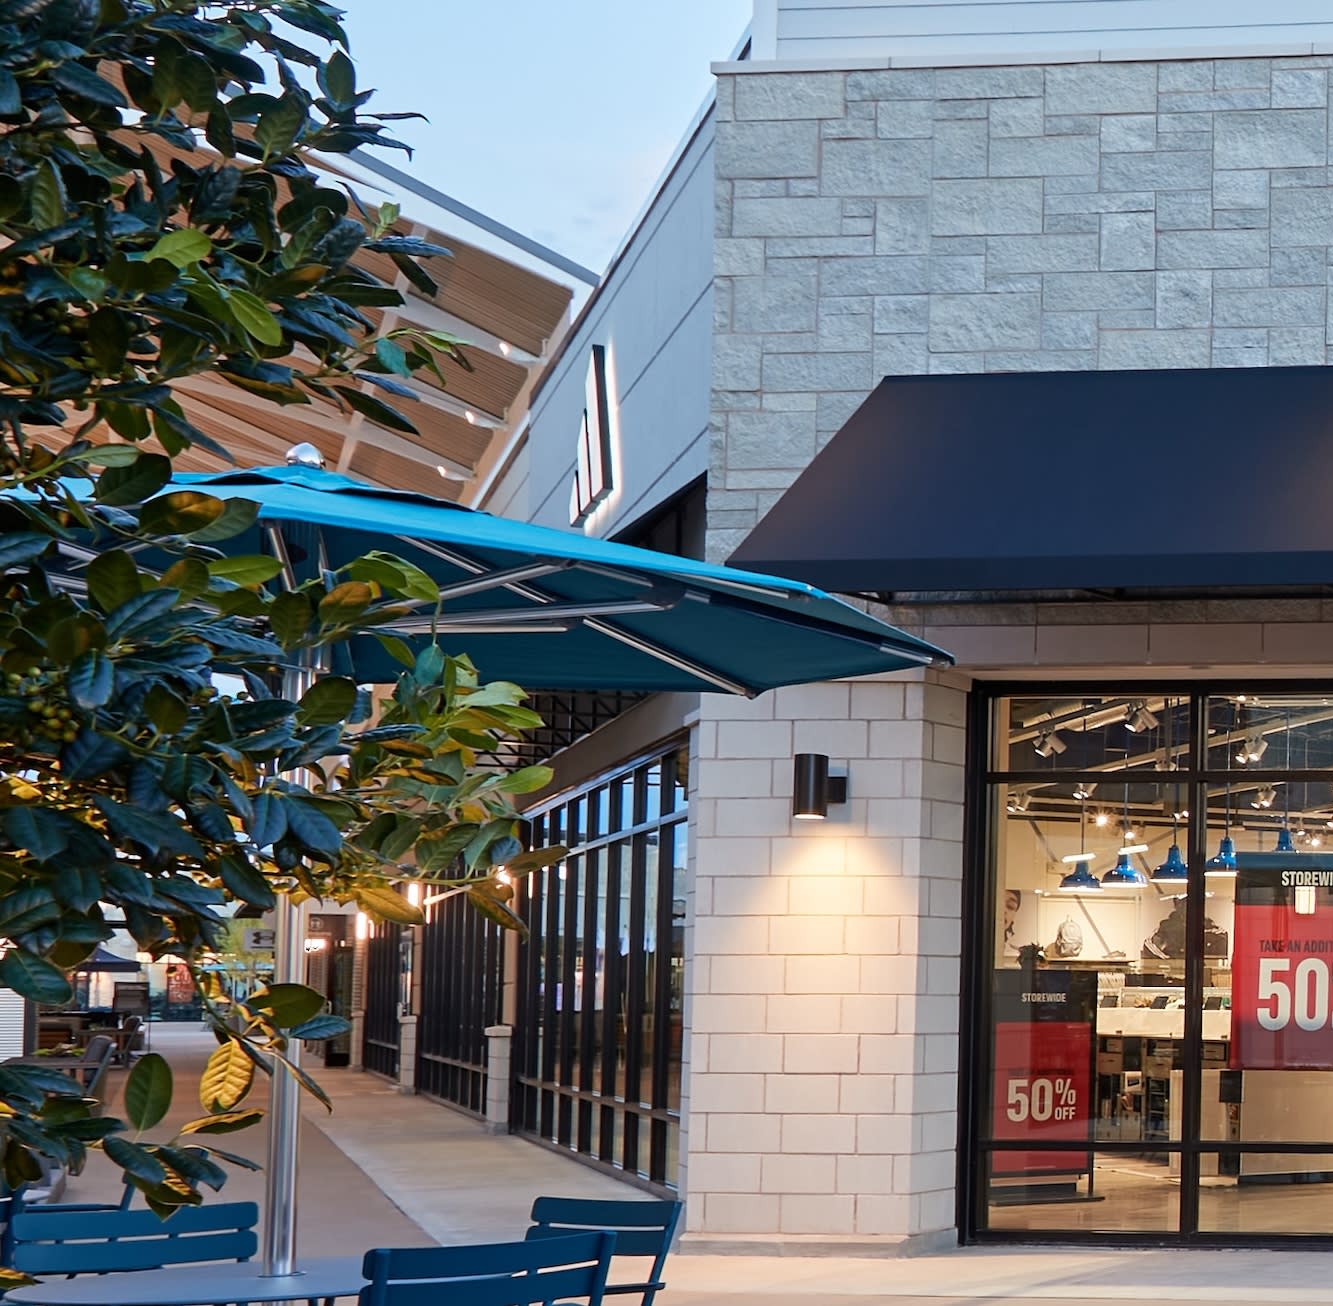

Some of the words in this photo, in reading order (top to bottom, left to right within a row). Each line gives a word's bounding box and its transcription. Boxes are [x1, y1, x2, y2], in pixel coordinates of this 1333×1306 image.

[1260, 940, 1284, 953] TAKE
[1288, 941, 1300, 953] AN
[1021, 993, 1067, 1003] STOREWIDE
[1006, 1078, 1076, 1122] 50%
[1054, 1106, 1076, 1121] OFF
